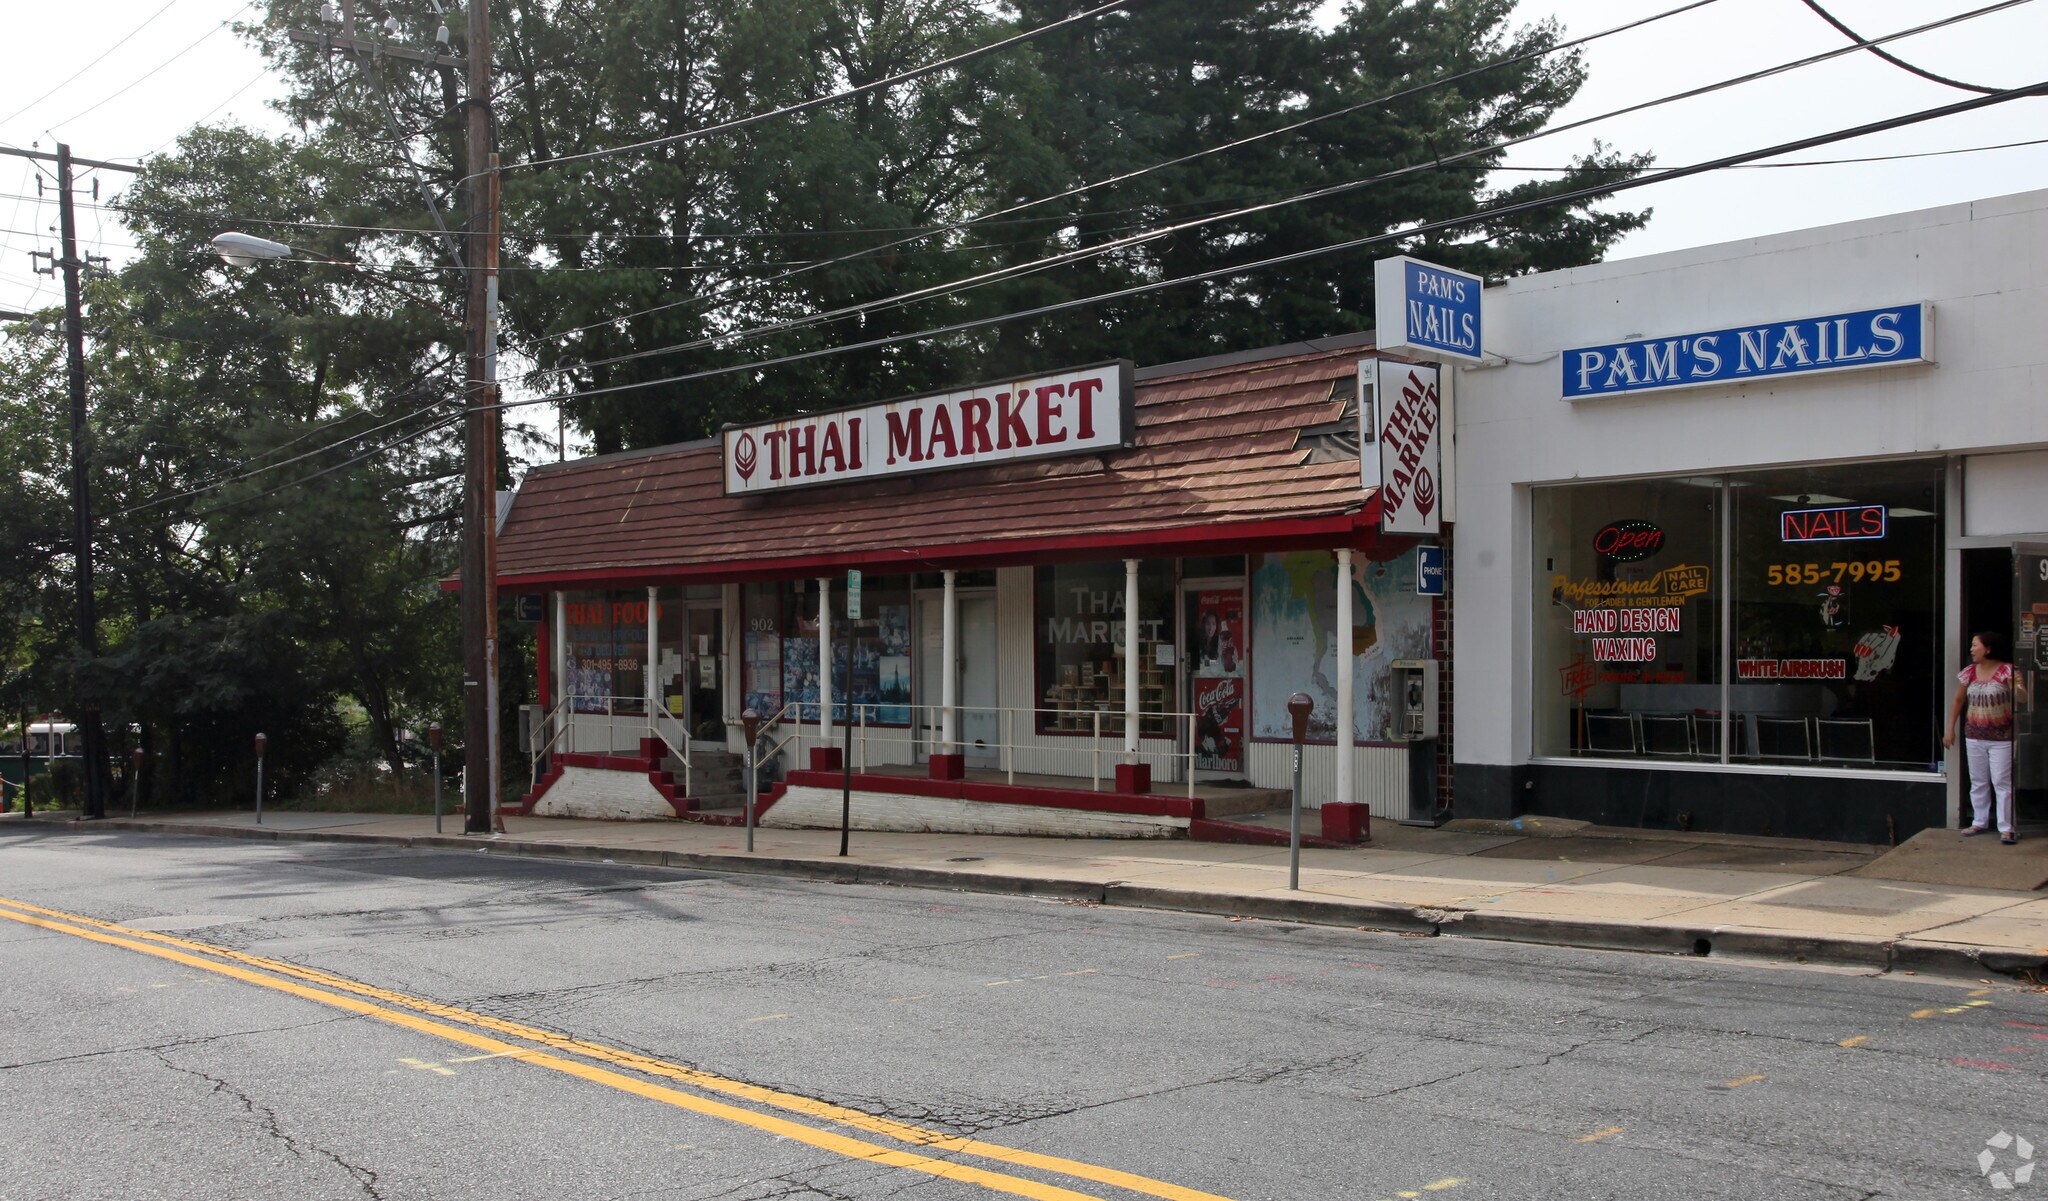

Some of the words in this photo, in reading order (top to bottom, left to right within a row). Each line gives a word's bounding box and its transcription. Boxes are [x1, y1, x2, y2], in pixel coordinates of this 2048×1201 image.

[1417, 271, 1466, 302] PAM'S
[1409, 299, 1475, 351] NAILS
[1577, 336, 1721, 390] PAM'S
[1737, 312, 1906, 374] NAILS
[1381, 369, 1425, 453] THAI
[763, 417, 863, 480] THAI
[885, 378, 1103, 466] MARKET
[1384, 382, 1439, 525] MARKET
[1785, 508, 1882, 539] NAILS
[1595, 527, 1663, 554] Open
[1423, 566, 1443, 576] PHONE
[1668, 569, 1701, 581] NAIL
[1767, 560, 1902, 586] 585-7995
[1552, 571, 1663, 601] Professional
[1671, 578, 1704, 592] CARE
[1070, 586, 1126, 614] THA
[1585, 597, 1598, 607] FOR
[1601, 597, 1626, 607] LADIES
[1637, 595, 1686, 607] GENTLEMEN
[751, 618, 774, 632] 902
[1574, 609, 1617, 634] HAND
[1621, 608, 1680, 633] DESIGN
[1593, 637, 1656, 662] WAXING
[1736, 658, 1778, 679] WHITE
[1779, 658, 1846, 680] AIRBRUSH
